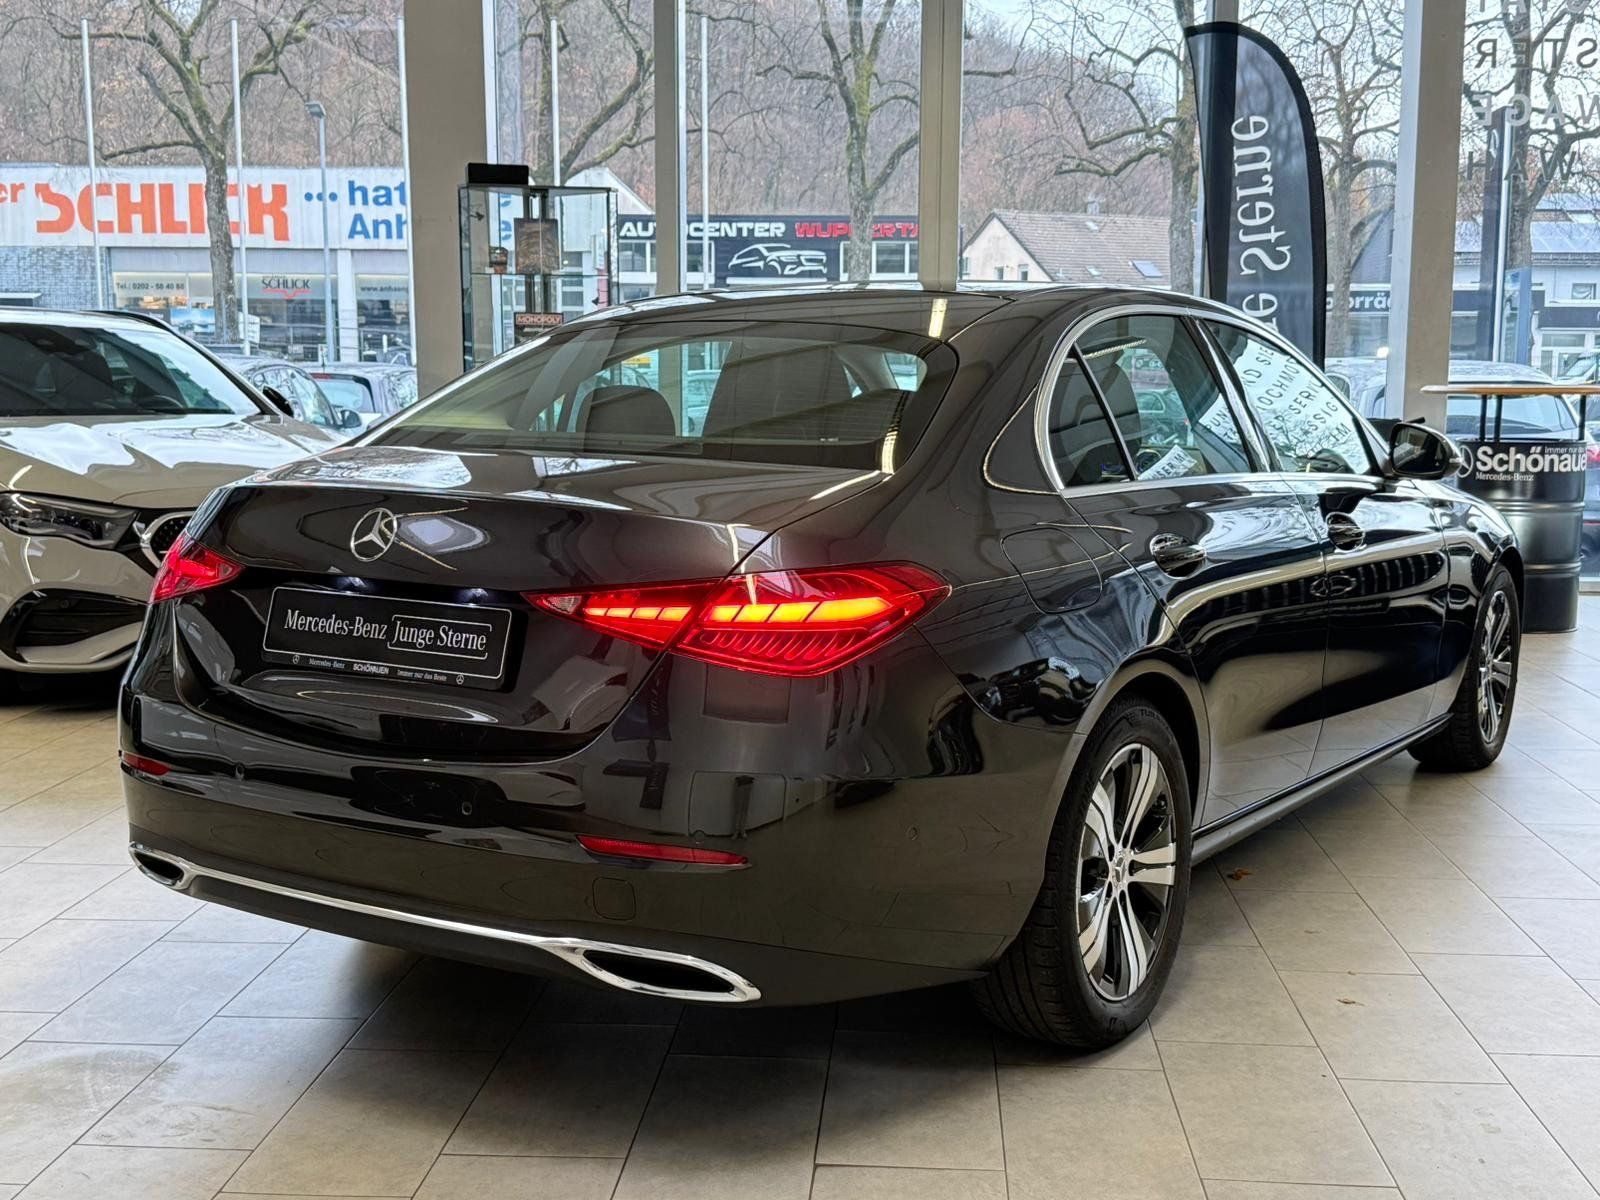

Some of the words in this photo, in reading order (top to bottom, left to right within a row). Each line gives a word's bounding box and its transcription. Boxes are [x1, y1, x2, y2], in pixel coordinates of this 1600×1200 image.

[348, 180, 407, 207] hat
[619, 221, 786, 238] AUCENTER
[795, 222, 920, 238] WUPERT
[262, 278, 311, 290] SCHLICK
[516, 313, 562, 325] MONOPOLY
[1476, 472, 1534, 481] Mercedes-Benz
[284, 609, 388, 640] Mercedes-Benz
[393, 621, 435, 649] Junge
[437, 625, 487, 651] Sterne
